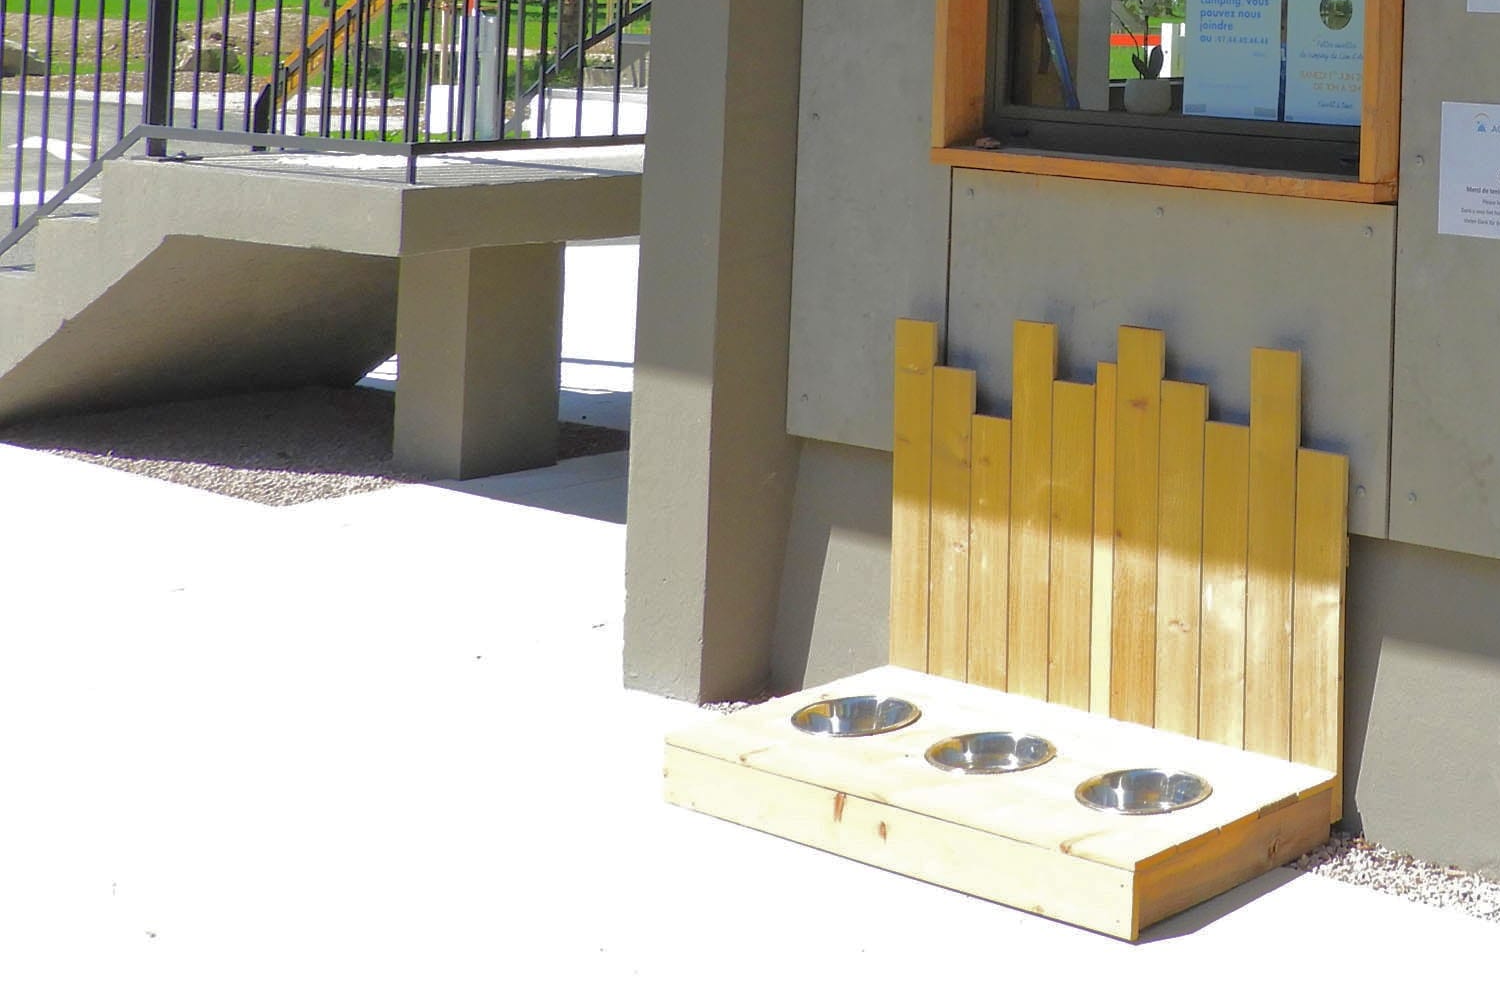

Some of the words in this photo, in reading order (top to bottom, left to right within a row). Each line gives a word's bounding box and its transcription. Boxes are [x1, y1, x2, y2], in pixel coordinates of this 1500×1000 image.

[1200, 10, 1235, 21] pouvez
[1238, 10, 1261, 19] nous
[1200, 20, 1234, 32] joindre
